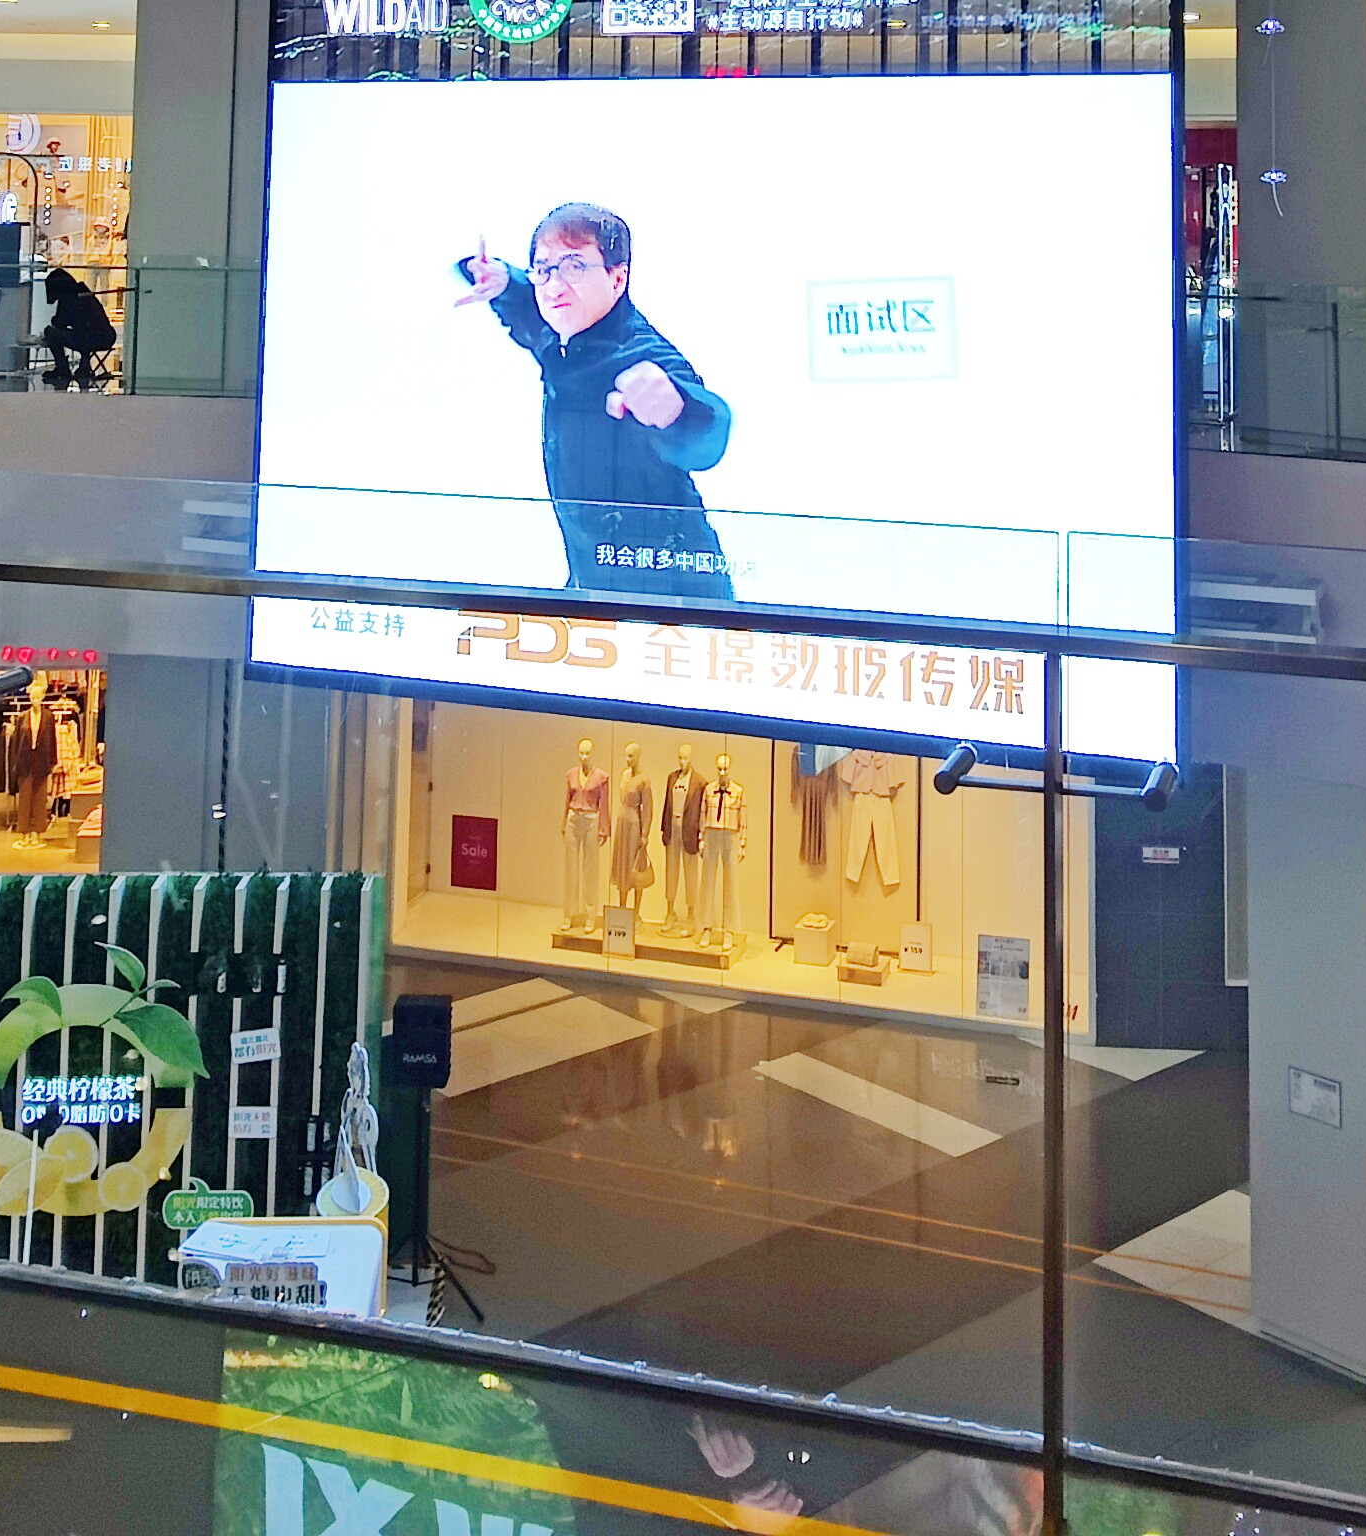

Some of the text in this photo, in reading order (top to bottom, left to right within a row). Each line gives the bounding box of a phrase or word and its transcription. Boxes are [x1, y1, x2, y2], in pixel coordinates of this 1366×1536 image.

[827, 299, 935, 335] 面试区
[309, 605, 405, 638] 公益支持
[461, 843, 489, 858] Sale
[402, 1052, 438, 1064] RAMSA
[22, 1076, 136, 1103] 经典柠檬茶
